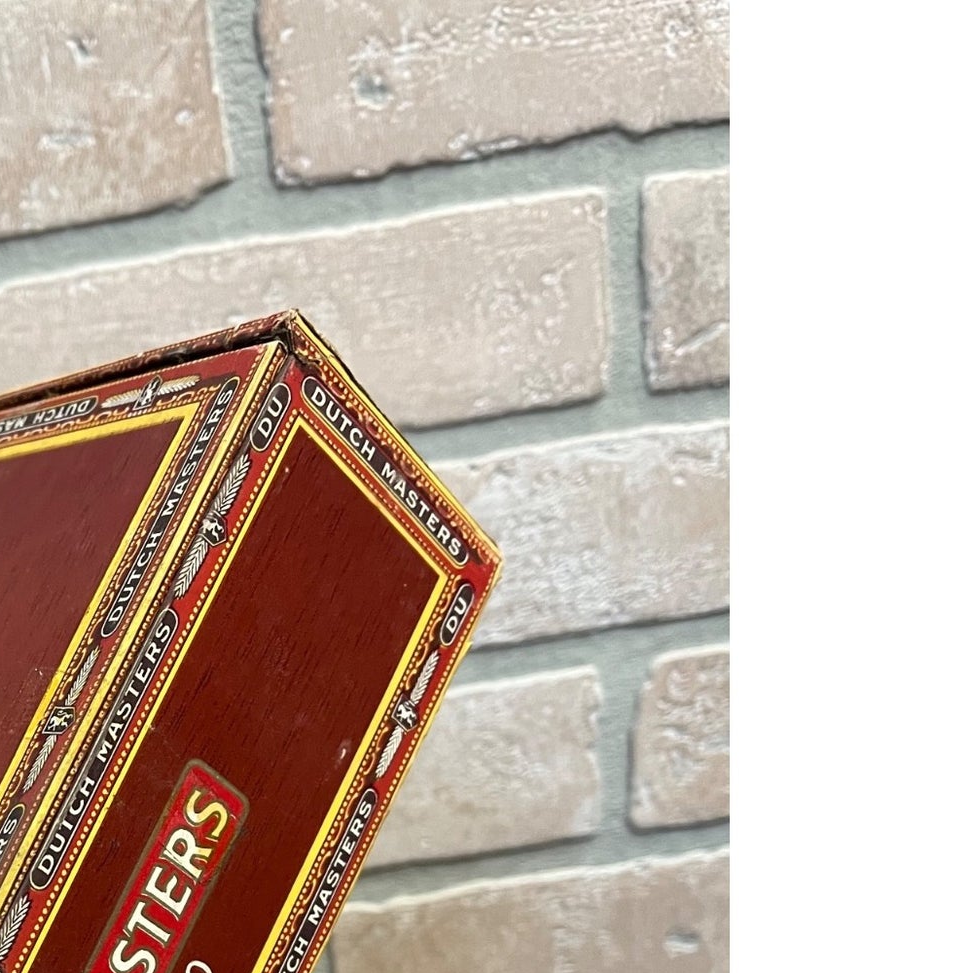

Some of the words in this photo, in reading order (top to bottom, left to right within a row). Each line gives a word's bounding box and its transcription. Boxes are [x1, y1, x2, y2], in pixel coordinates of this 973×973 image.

[32, 399, 91, 423] DUTCH
[258, 396, 284, 438] DU
[311, 386, 376, 461] DUTCH
[382, 462, 462, 557] MASTERS
[108, 532, 162, 623] DUTCH
[162, 388, 234, 517] MASTERS
[446, 599, 468, 634] DU
[37, 779, 95, 875] DUTCH
[97, 623, 171, 763] MASTERS
[307, 800, 372, 926] MASTERS
